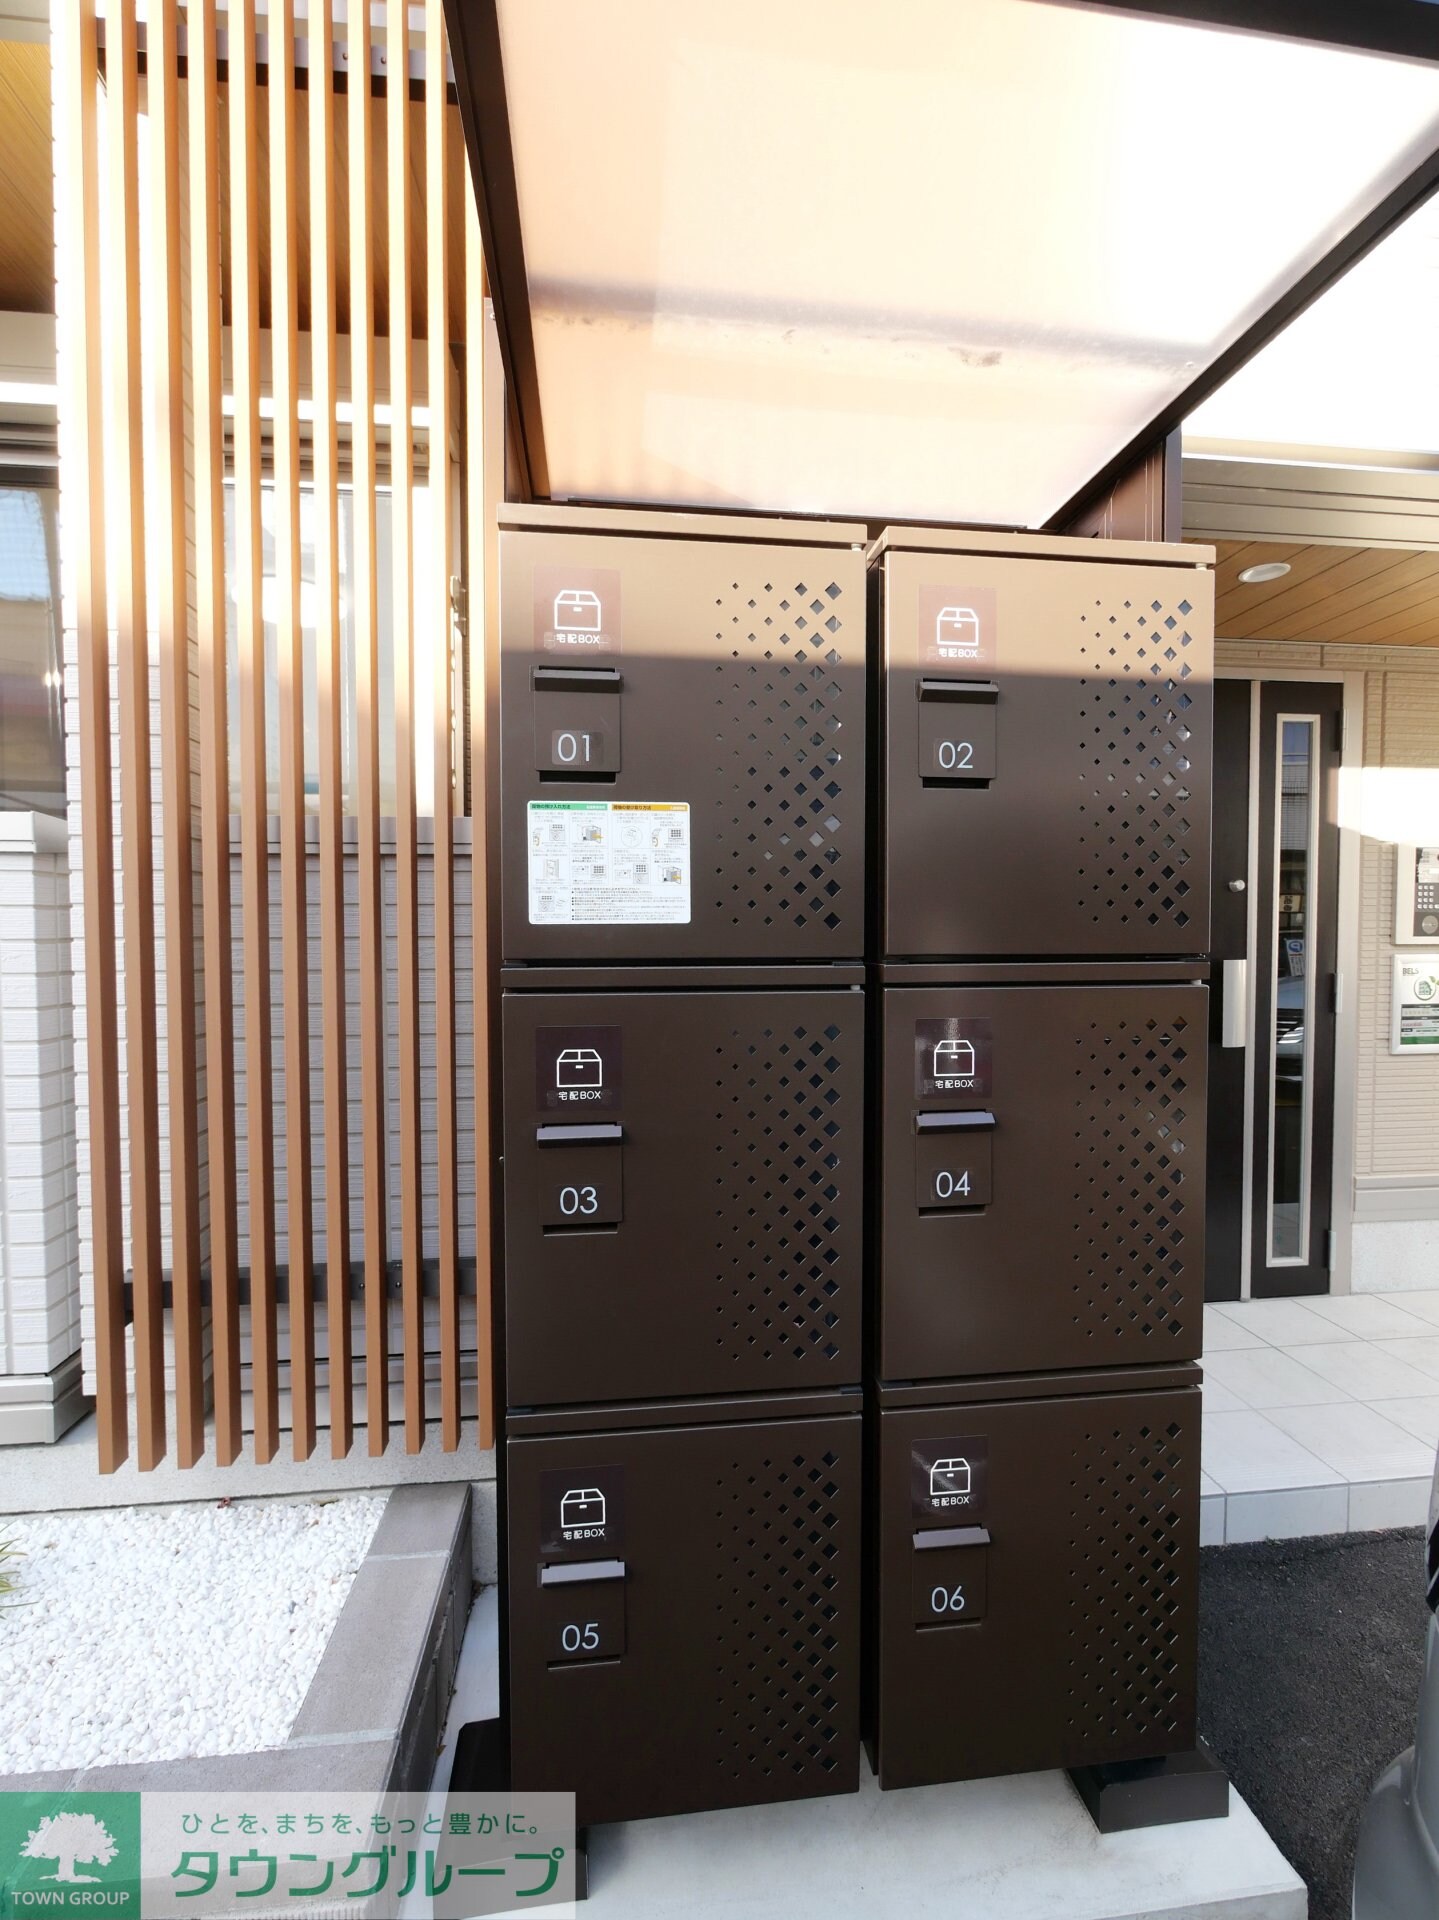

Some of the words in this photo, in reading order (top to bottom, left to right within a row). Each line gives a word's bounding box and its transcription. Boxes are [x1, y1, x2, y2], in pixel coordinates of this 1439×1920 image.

[556, 633, 600, 644] 宅配BOX
[938, 648, 978, 658] 宅配BOX
[557, 733, 590, 762] 01
[938, 741, 974, 769] 02
[1402, 967, 1419, 975] BELS
[934, 1079, 974, 1089] 宅配BOX
[558, 1090, 602, 1101] 宅配BOX
[936, 1170, 971, 1198] 04
[559, 1186, 598, 1215] 03
[931, 1495, 970, 1507] 宅配BOX
[562, 1528, 606, 1540] 宅配BOX
[931, 1585, 965, 1613] 06
[562, 1622, 599, 1651] 05
